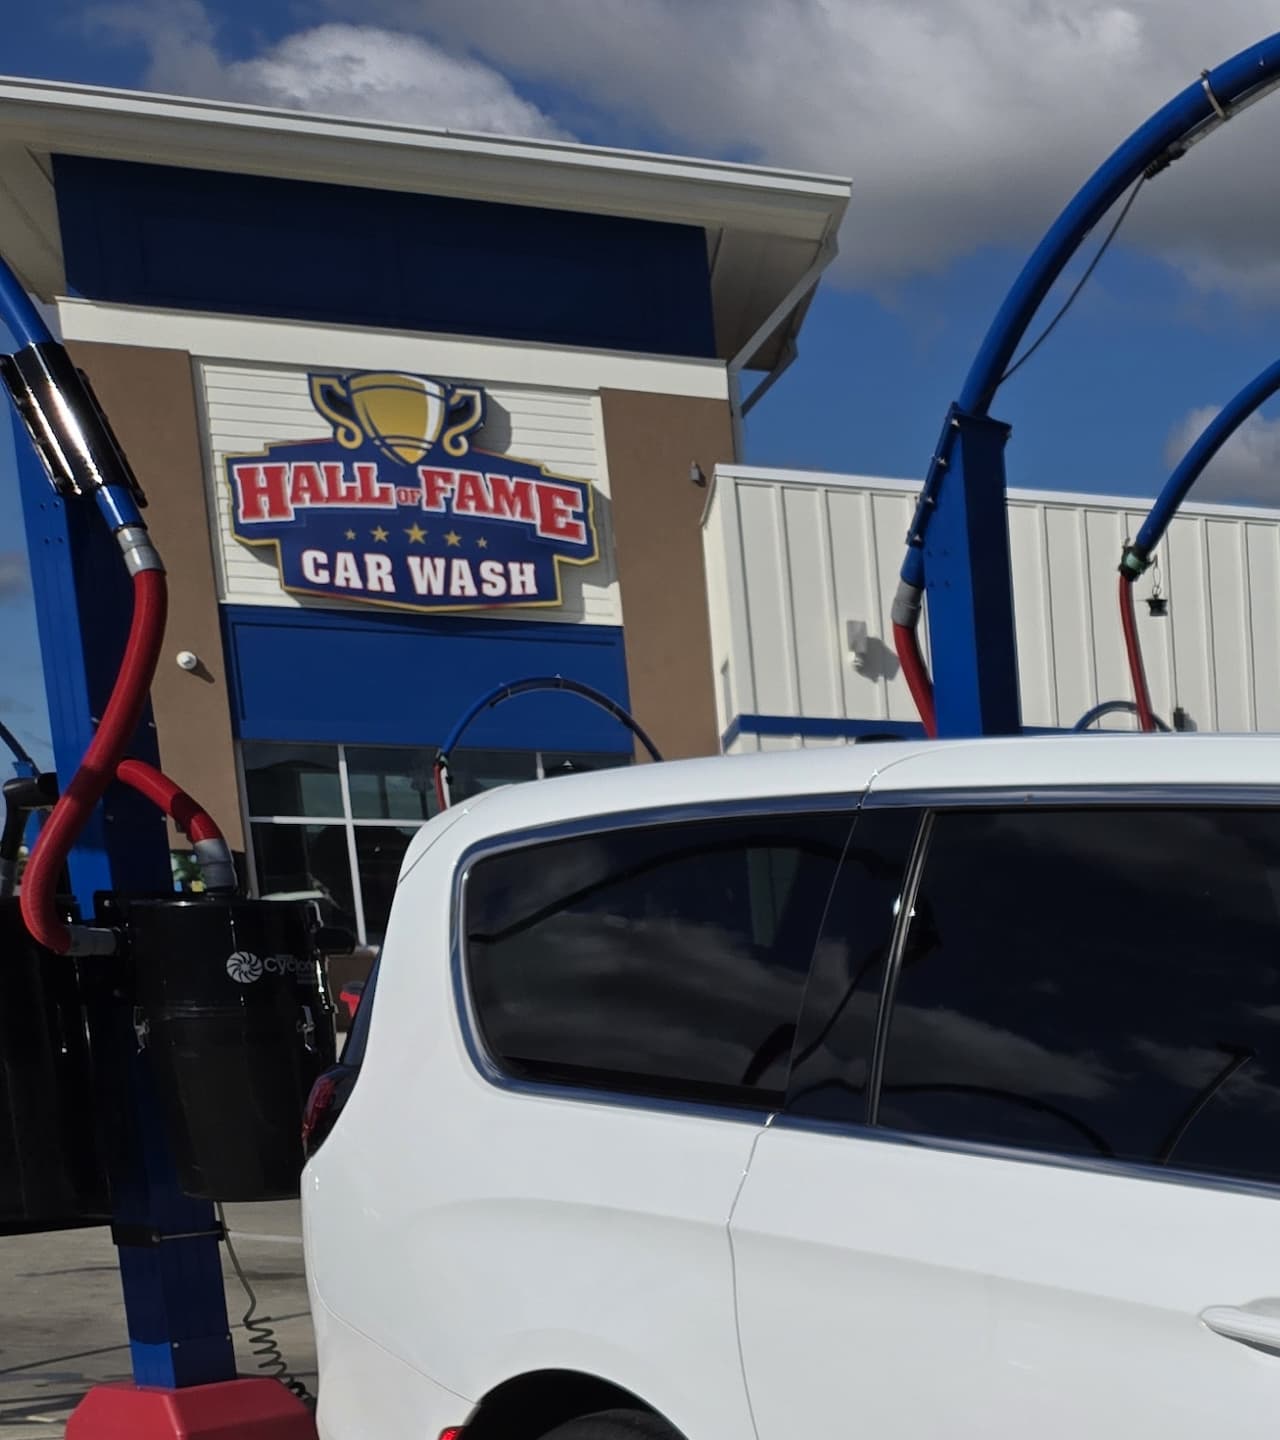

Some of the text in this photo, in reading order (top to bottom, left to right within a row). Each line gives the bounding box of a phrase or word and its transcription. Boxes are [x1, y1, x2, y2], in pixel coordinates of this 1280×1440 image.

[233, 461, 588, 545] HALL OF FAME
[301, 549, 539, 597] CAR WASH
